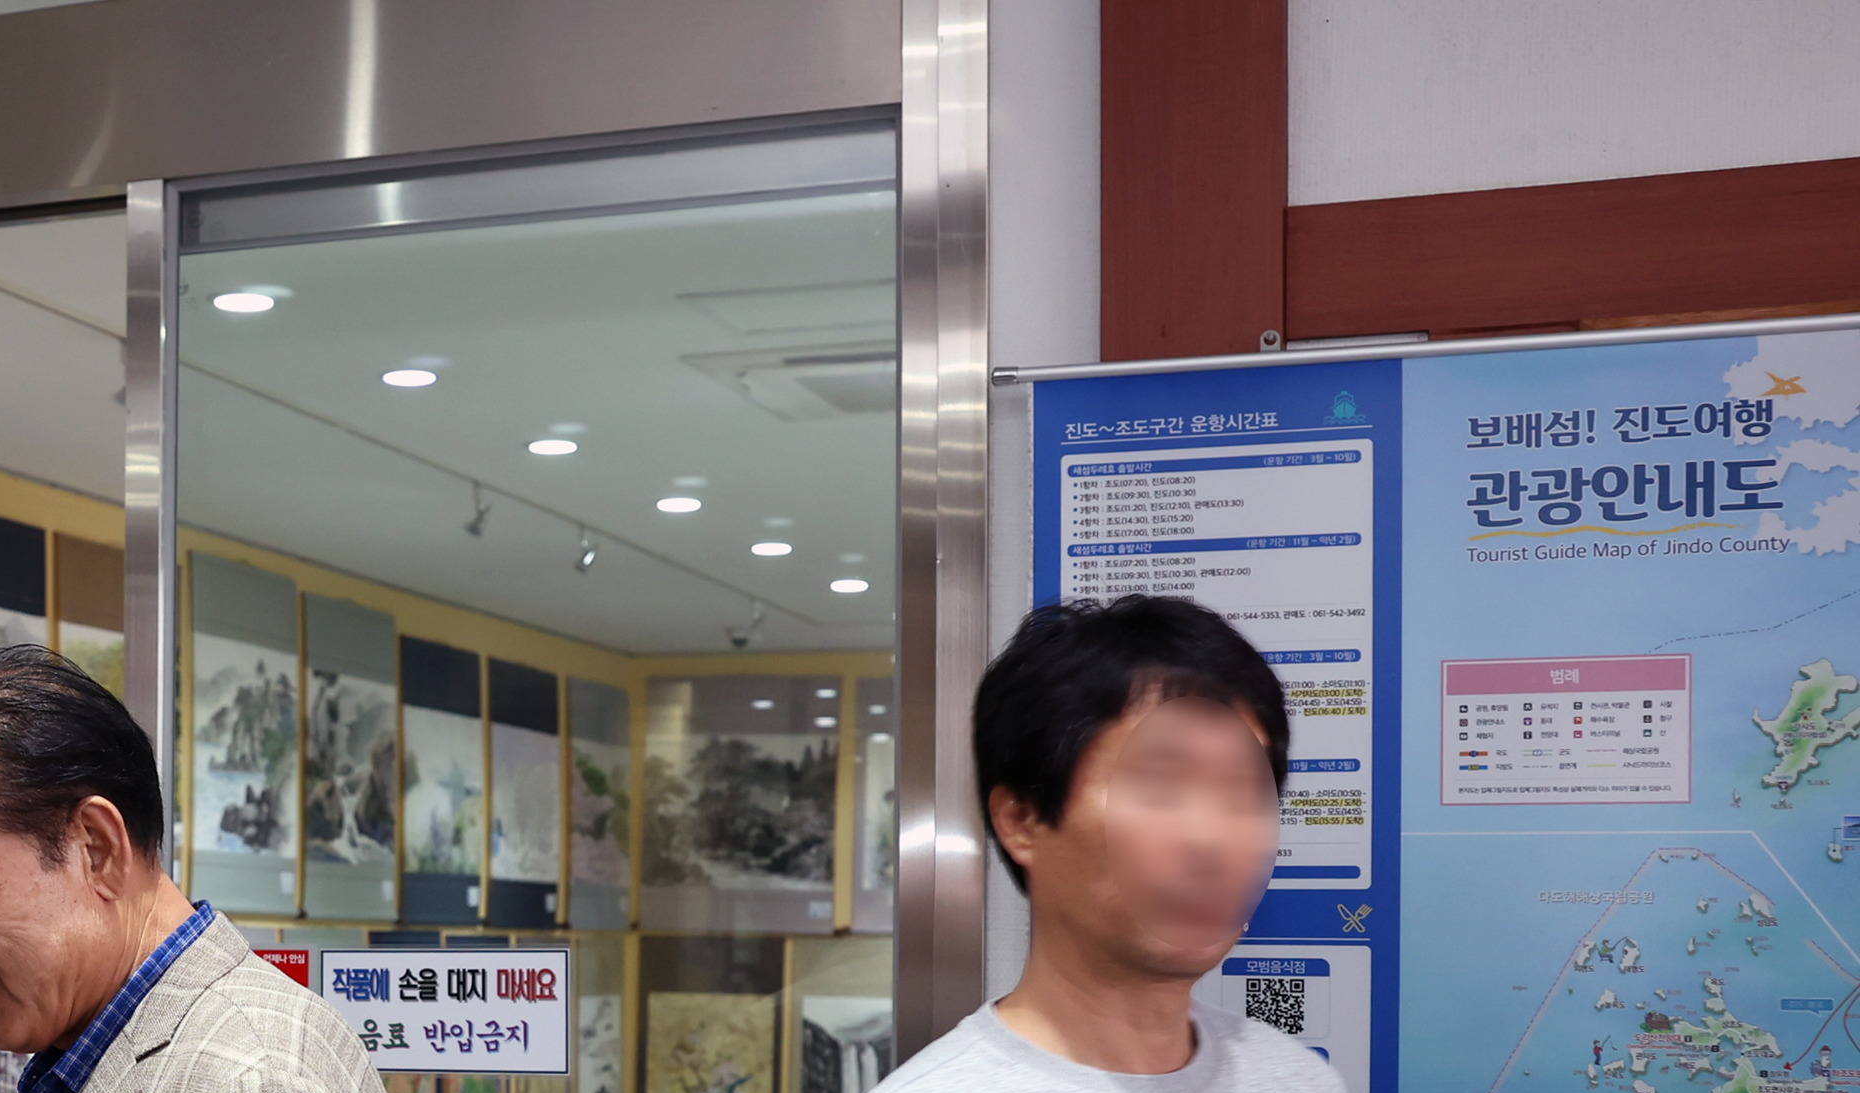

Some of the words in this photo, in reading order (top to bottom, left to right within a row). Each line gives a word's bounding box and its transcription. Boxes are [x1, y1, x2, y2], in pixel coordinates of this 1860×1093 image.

[1190, 411, 1279, 432] 운항시간표
[1466, 409, 1596, 450] 보배섬!
[1612, 398, 1774, 444] 진도여행
[1286, 455, 1303, 465] 기간
[1310, 454, 1324, 464] 3월
[1118, 463, 1152, 474] 출발시간
[1152, 476, 1196, 487] 진도(08:20)
[1154, 488, 1197, 499] 진도(10:30)
[1466, 458, 1785, 528] 관광안내도
[1152, 514, 1194, 524] 진도(15:20)
[1152, 526, 1195, 536] 진도(18:00)
[1269, 536, 1286, 547] 기간
[1118, 543, 1152, 553] 출발시간
[1467, 546, 1529, 563] Tourist
[1534, 544, 1587, 560] Guide
[1593, 542, 1632, 560] Map
[1637, 540, 1658, 556] of
[1663, 538, 1713, 556] Jindo
[1719, 536, 1791, 555] County
[1151, 557, 1196, 567] 진도(08:20)
[1152, 582, 1195, 592] 진도(14:00)
[1313, 608, 1366, 618] 061-542-3492
[1286, 651, 1303, 662] 기간
[1310, 651, 1324, 662] 3월
[1550, 668, 1580, 685] 범례
[1246, 960, 1306, 975] 모범음식점
[332, 967, 390, 1002] 작품에
[398, 967, 439, 1002] 손을
[447, 967, 486, 1002] 대지
[496, 967, 558, 1002] 마세요
[357, 1018, 410, 1050] 음료
[424, 1019, 530, 1054] 반입금지
